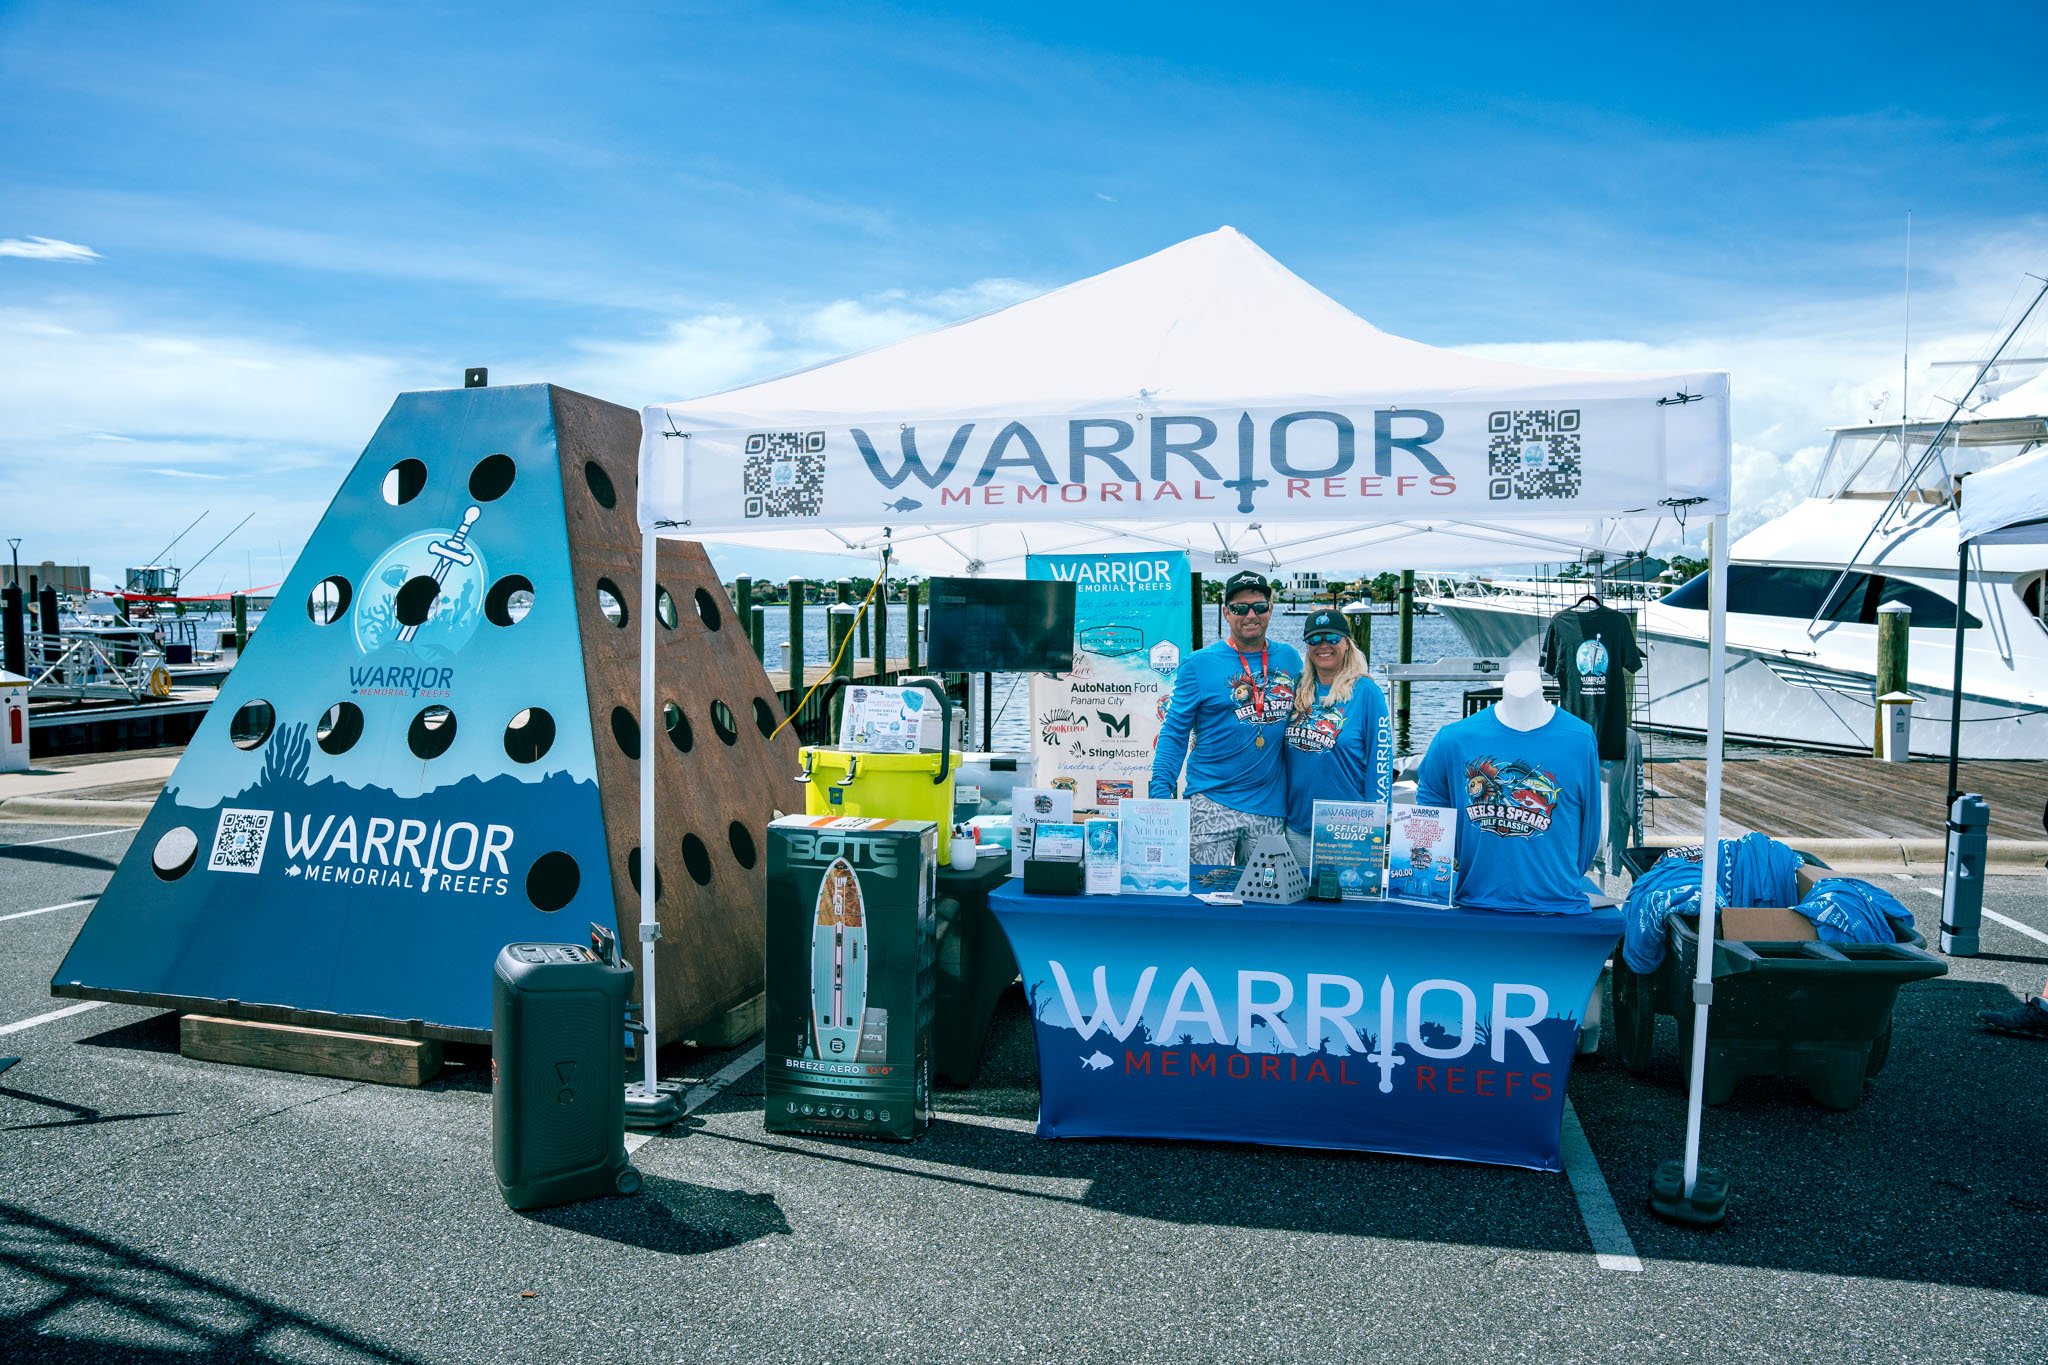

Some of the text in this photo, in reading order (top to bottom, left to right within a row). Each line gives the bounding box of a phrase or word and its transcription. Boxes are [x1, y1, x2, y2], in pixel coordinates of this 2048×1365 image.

[850, 409, 1450, 513] WARRIOR
[941, 475, 1457, 506] MEMORIAL REEFS
[1050, 560, 1171, 592] WARRIOR
[1078, 582, 1172, 593] EMORIAL REEFS
[350, 666, 453, 697] WARRIOR
[1070, 682, 1158, 693] AutoNation Ford
[359, 688, 450, 698] MEMORIAL REEFS
[1070, 696, 1124, 706] Panama City
[1235, 704, 1257, 720] REEL
[1263, 702, 1270, 711] &
[1285, 727, 1336, 749] EELS & SPEARS
[1088, 748, 1150, 759] StingMaster
[1327, 808, 1375, 820] WARRIOR
[1411, 808, 1440, 818] WARRIOR
[1466, 804, 1551, 831] REELS & SPEARS
[1326, 824, 1374, 834] OFFICIAL
[1498, 819, 1529, 833] CLASSIC
[1333, 832, 1366, 841] SWAG
[284, 811, 514, 893] WARRIOR
[304, 864, 509, 896] MEMORIAL REEFS
[1390, 868, 1413, 878] $40.00
[1048, 960, 1551, 1094] WARRIOR
[785, 1059, 825, 1071] BREEZE
[1125, 1049, 1552, 1101] MEMORIAL REEFS
